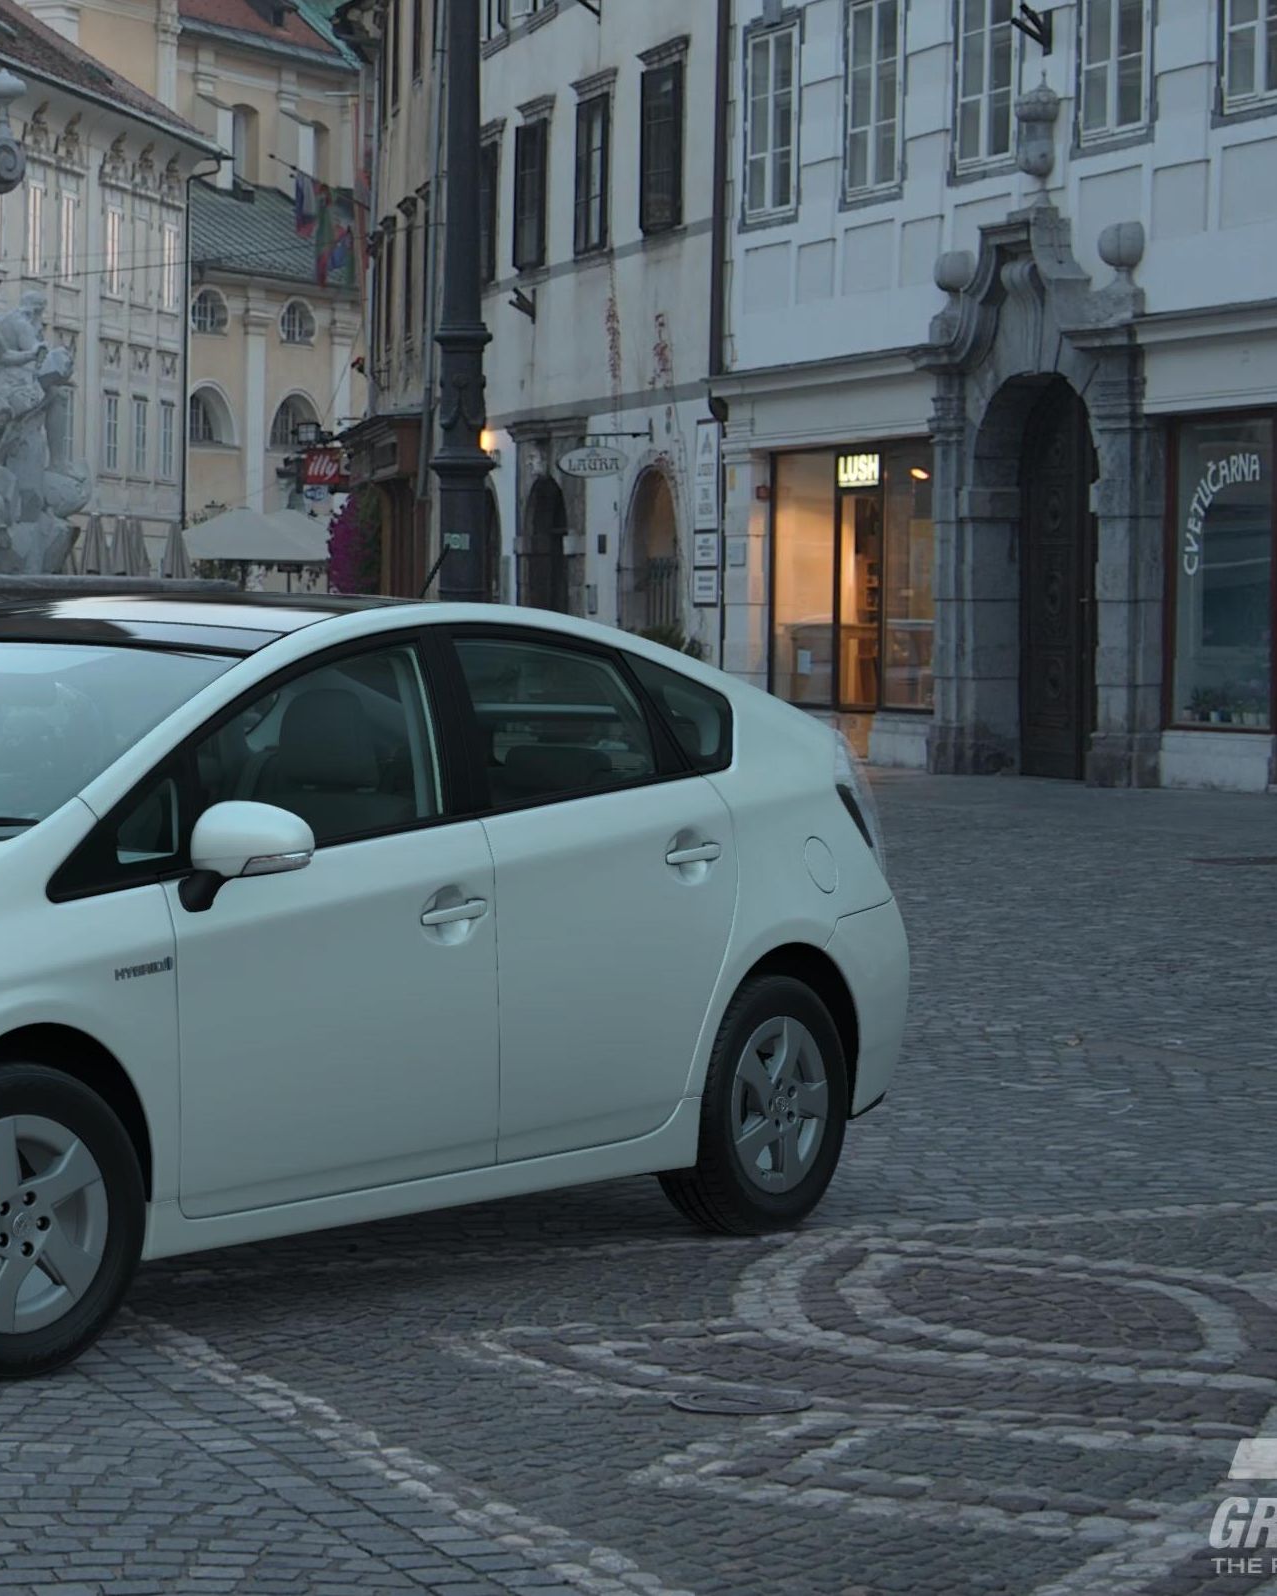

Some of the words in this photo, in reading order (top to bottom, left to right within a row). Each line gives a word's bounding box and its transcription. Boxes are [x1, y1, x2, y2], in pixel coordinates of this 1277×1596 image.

[308, 454, 339, 481] illy
[568, 458, 619, 471] LAURA
[838, 454, 879, 482] LUSH
[1184, 453, 1260, 576] CVETLIČARNA
[114, 961, 164, 981] HYBRID
